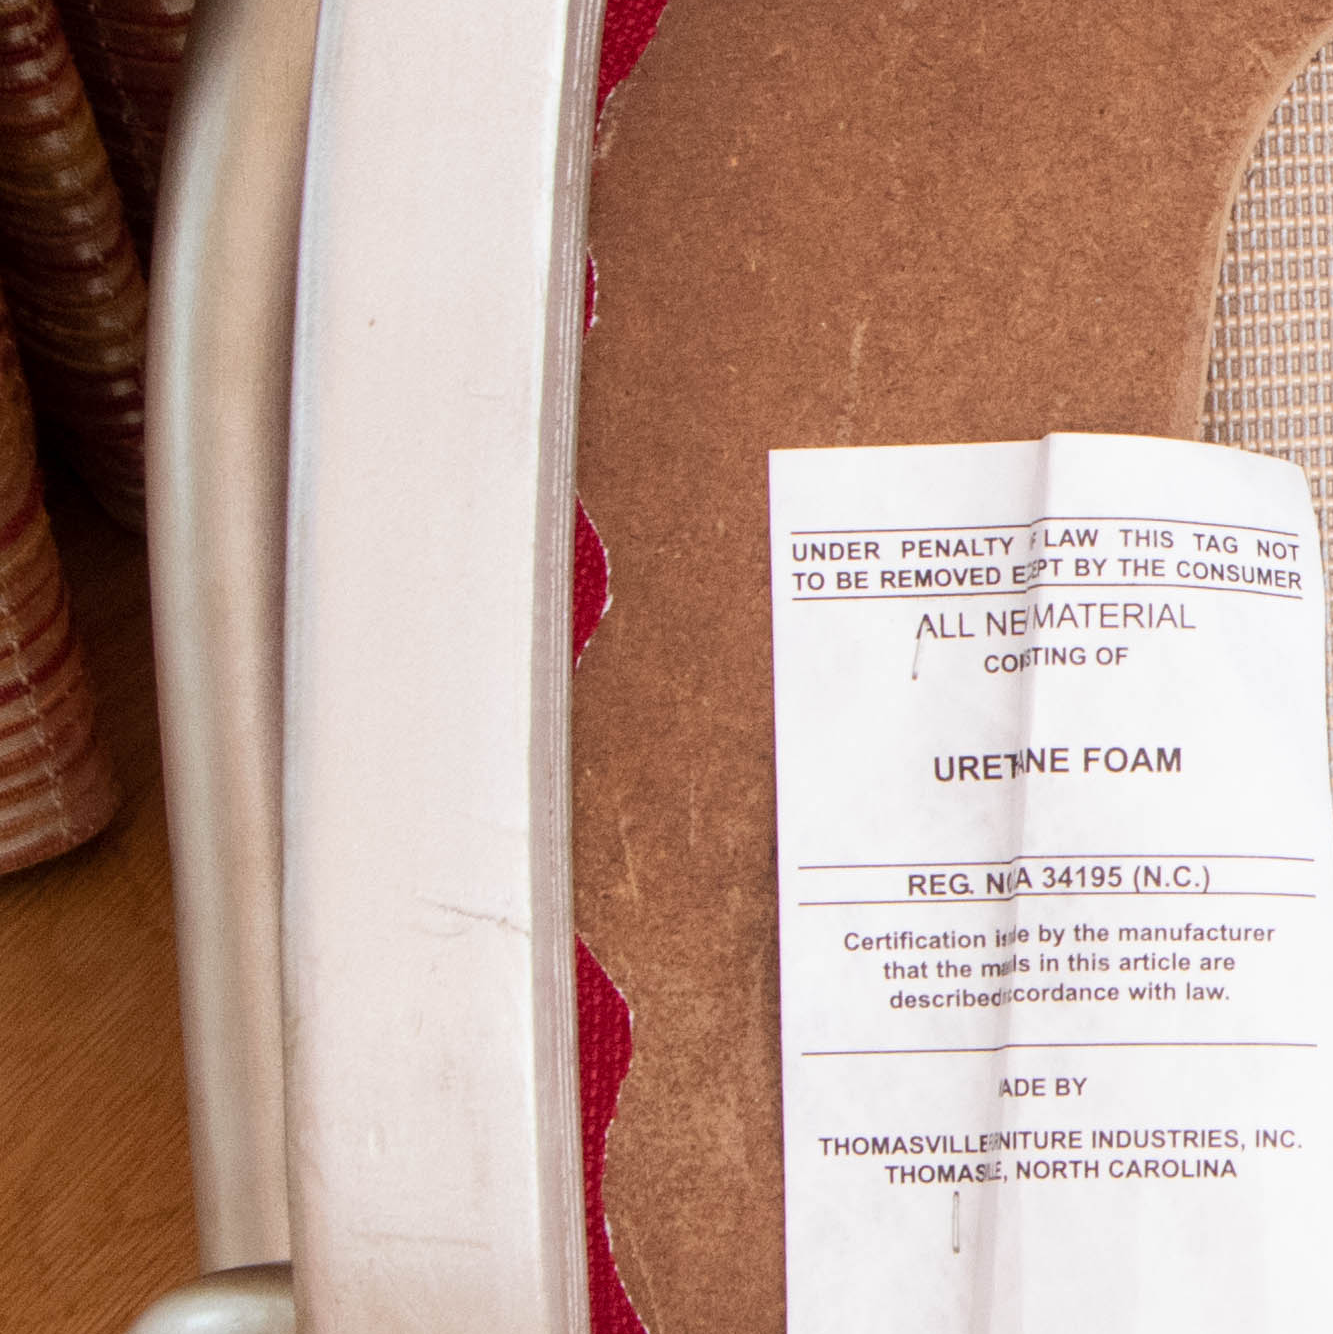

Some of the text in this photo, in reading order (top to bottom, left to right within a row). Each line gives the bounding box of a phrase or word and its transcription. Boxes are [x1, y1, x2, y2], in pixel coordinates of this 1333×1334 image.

[792, 541, 880, 562] UNDER
[901, 536, 1014, 559] PENALTY
[1044, 528, 1099, 547] LAW
[1118, 529, 1174, 549] THIS
[1192, 533, 1238, 554] TAG
[1256, 539, 1300, 562] NOT
[792, 571, 825, 591] TO
[835, 571, 869, 590] BE
[880, 566, 1001, 589] REMOVED
[1074, 558, 1108, 577] BY
[1117, 558, 1166, 577] THE
[1174, 558, 1302, 592] CONSUMER
[914, 612, 977, 642] ALL
[1032, 603, 1196, 630] MATERIAL
[1095, 646, 1129, 666] OF
[1083, 747, 1182, 773] FOAM
[908, 873, 975, 896] REG.
[1042, 866, 1122, 889] 34195
[1131, 865, 1212, 894] (N.C.)
[844, 929, 986, 951] Certification
[1038, 923, 1066, 947] by
[1073, 923, 1110, 942] the
[1118, 923, 1276, 942] manufacturer
[882, 960, 928, 980] that
[936, 959, 972, 979] the
[1040, 953, 1059, 973] in
[1067, 952, 1110, 972] this
[1118, 952, 1191, 971] article
[1200, 957, 1236, 971] are
[1128, 982, 1176, 1001] with
[1186, 981, 1229, 1001] law.
[999, 1077, 1088, 1098] ADE BY
[1092, 1129, 1245, 1152] INDUSTRIES,
[1255, 1129, 1302, 1149] INC.
[1016, 1159, 1099, 1180] NORTH
[1108, 1159, 1237, 1179] CAROLINA
